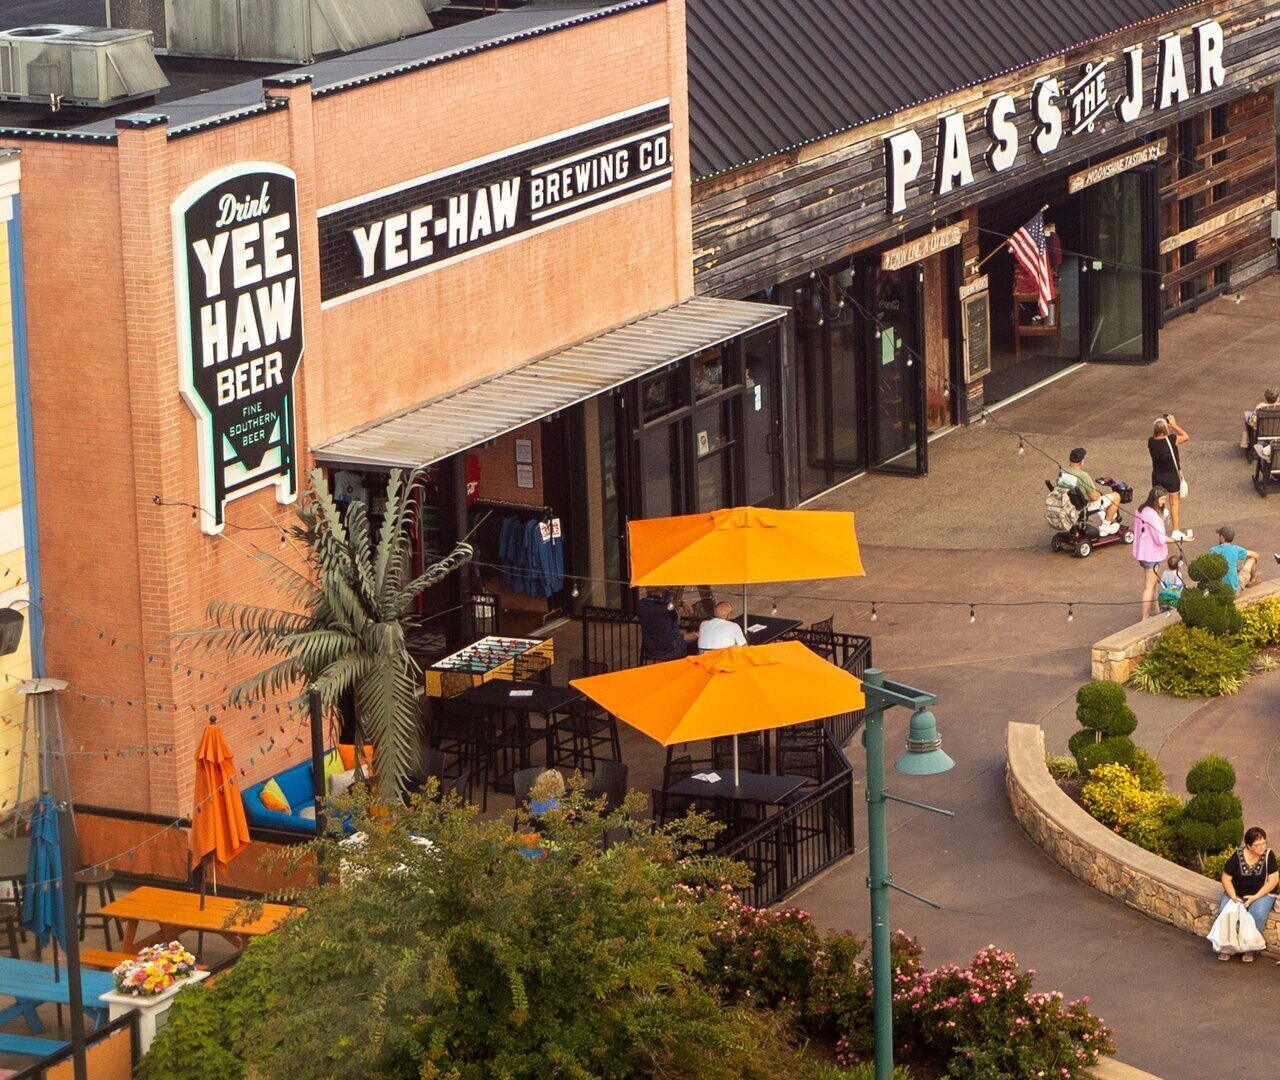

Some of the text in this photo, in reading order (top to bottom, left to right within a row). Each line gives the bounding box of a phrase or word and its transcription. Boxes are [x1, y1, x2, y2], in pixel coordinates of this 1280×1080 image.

[886, 20, 1226, 214] PASS THE JAR
[216, 180, 270, 228] Drink
[352, 135, 674, 278] YEE-HAW BREWING CO.
[192, 212, 293, 298] YEE
[200, 276, 296, 368] HAW
[217, 350, 283, 407] BEER
[229, 410, 277, 437] SOUTHERN
[242, 401, 263, 418] FINE
[242, 429, 265, 446] BEER
